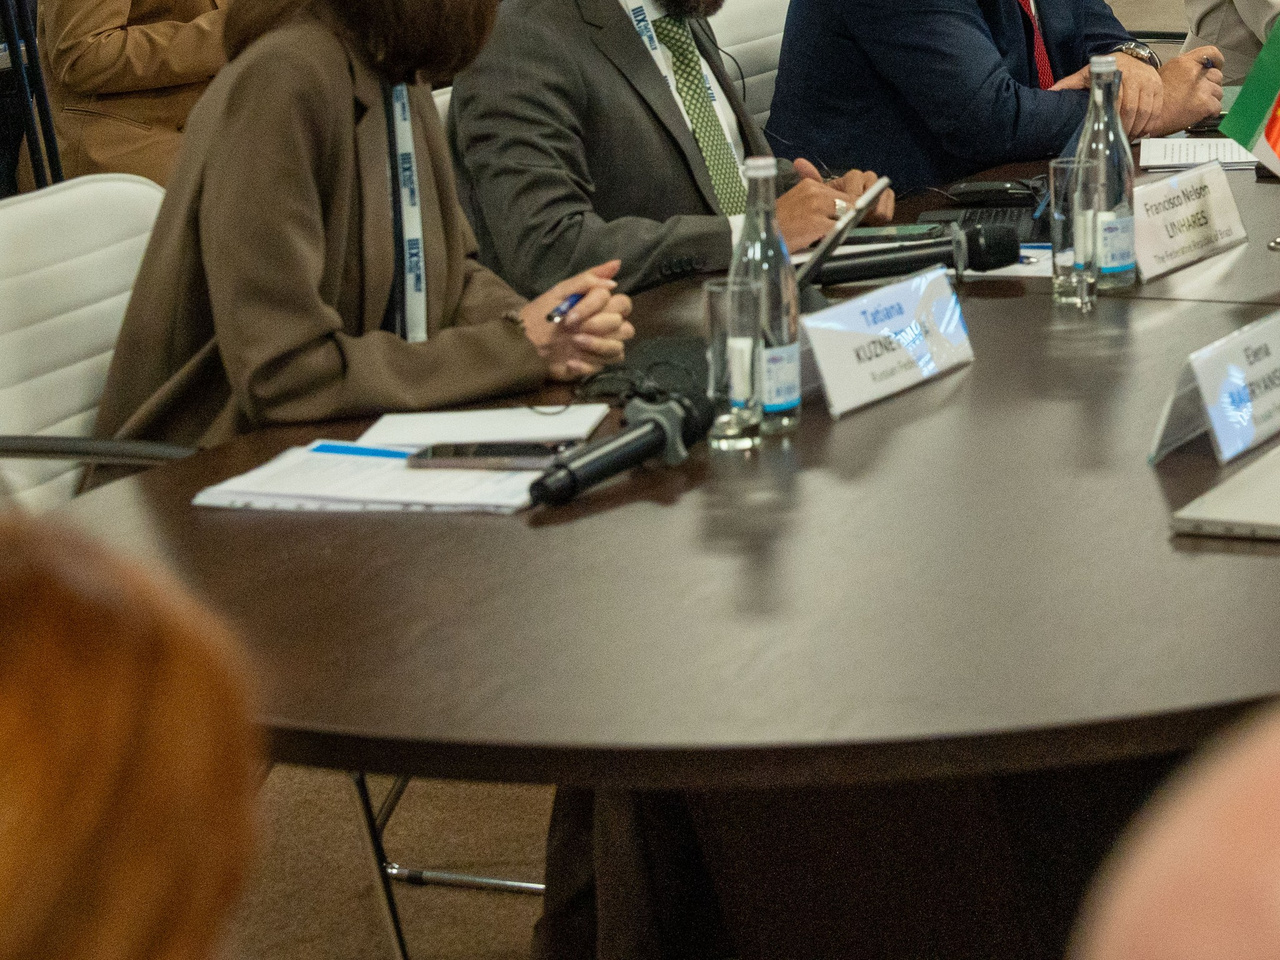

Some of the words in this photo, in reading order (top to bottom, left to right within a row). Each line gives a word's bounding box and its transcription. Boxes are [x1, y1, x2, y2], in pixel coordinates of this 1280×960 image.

[1144, 194, 1184, 217] Francisco
[1183, 183, 1212, 203] Nelson
[1165, 210, 1209, 239] LINHARES
[860, 302, 905, 327] Tatiana
